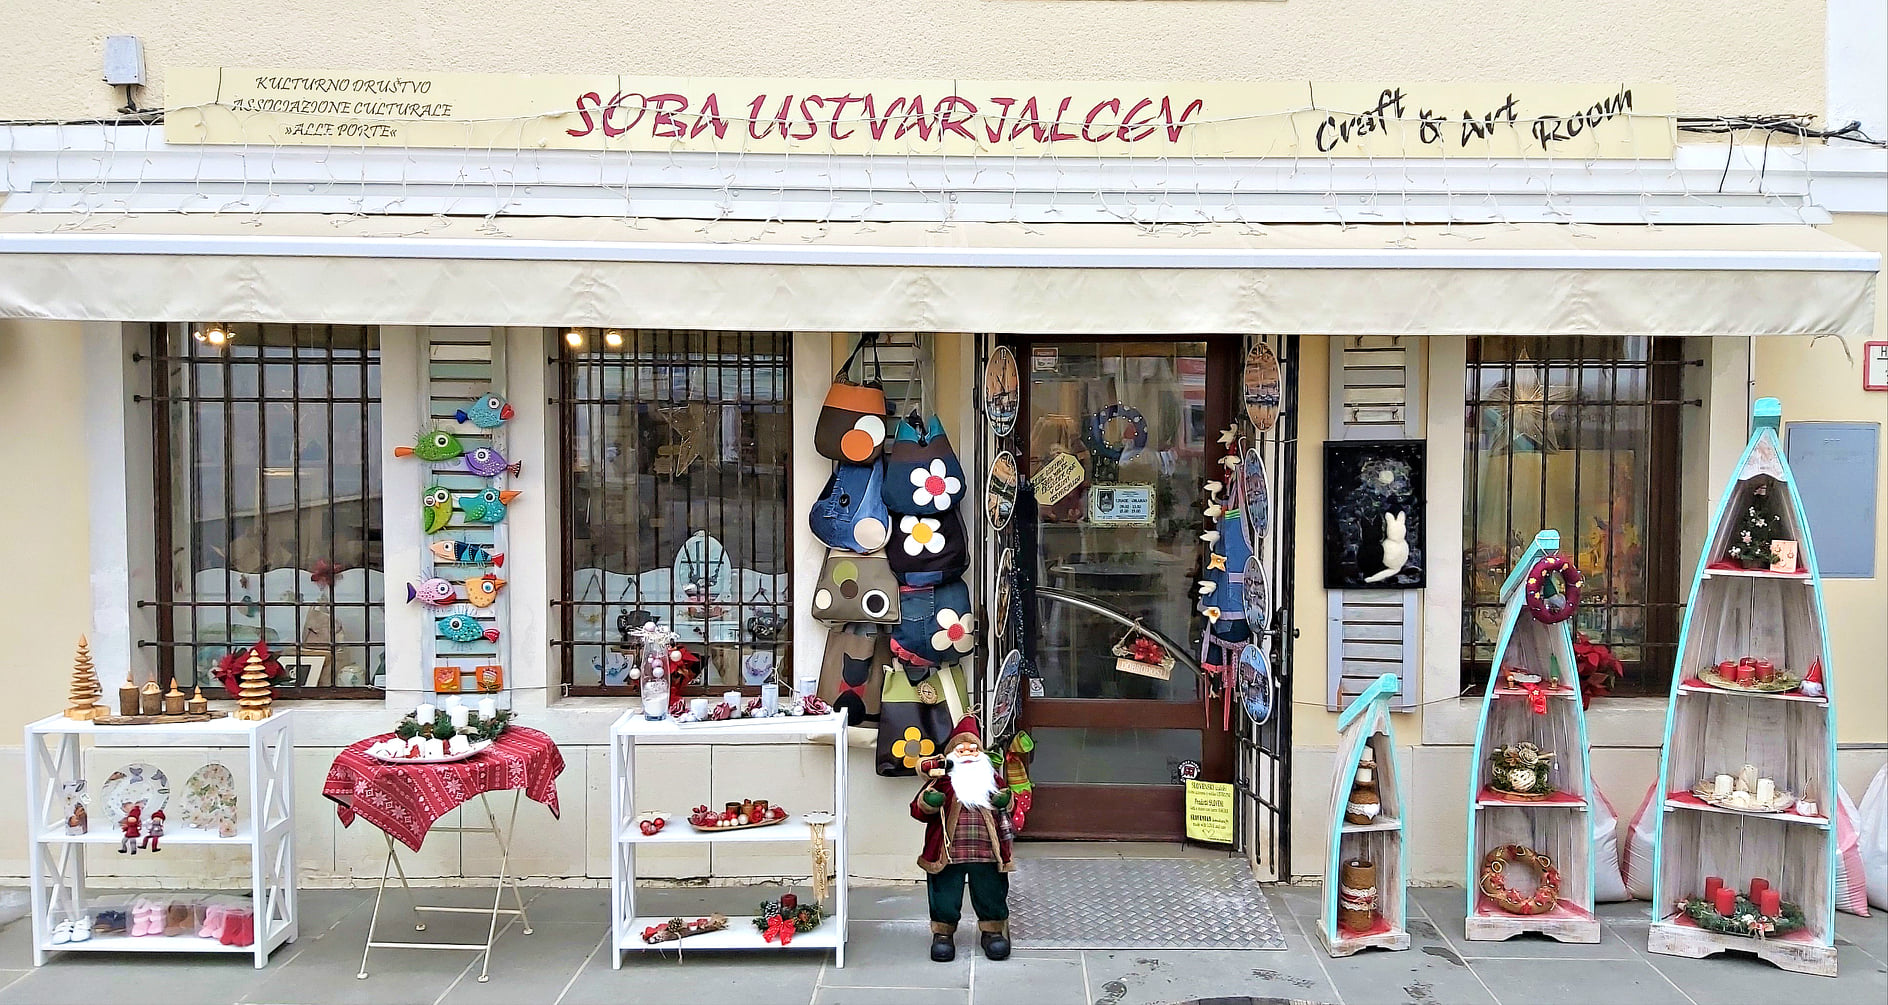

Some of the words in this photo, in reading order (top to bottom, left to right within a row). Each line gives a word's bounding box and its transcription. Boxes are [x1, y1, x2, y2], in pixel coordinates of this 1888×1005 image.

[255, 77, 350, 92] KULTURNO
[352, 77, 432, 94] DRUŠTVO
[231, 98, 351, 115] ASSOCIAZIONE
[353, 101, 453, 118] CULTURALE
[565, 91, 729, 140] SOBA
[1316, 87, 1407, 152] Craft
[1419, 107, 1447, 144] &
[1462, 93, 1520, 148] Art
[1532, 88, 1633, 151] Room
